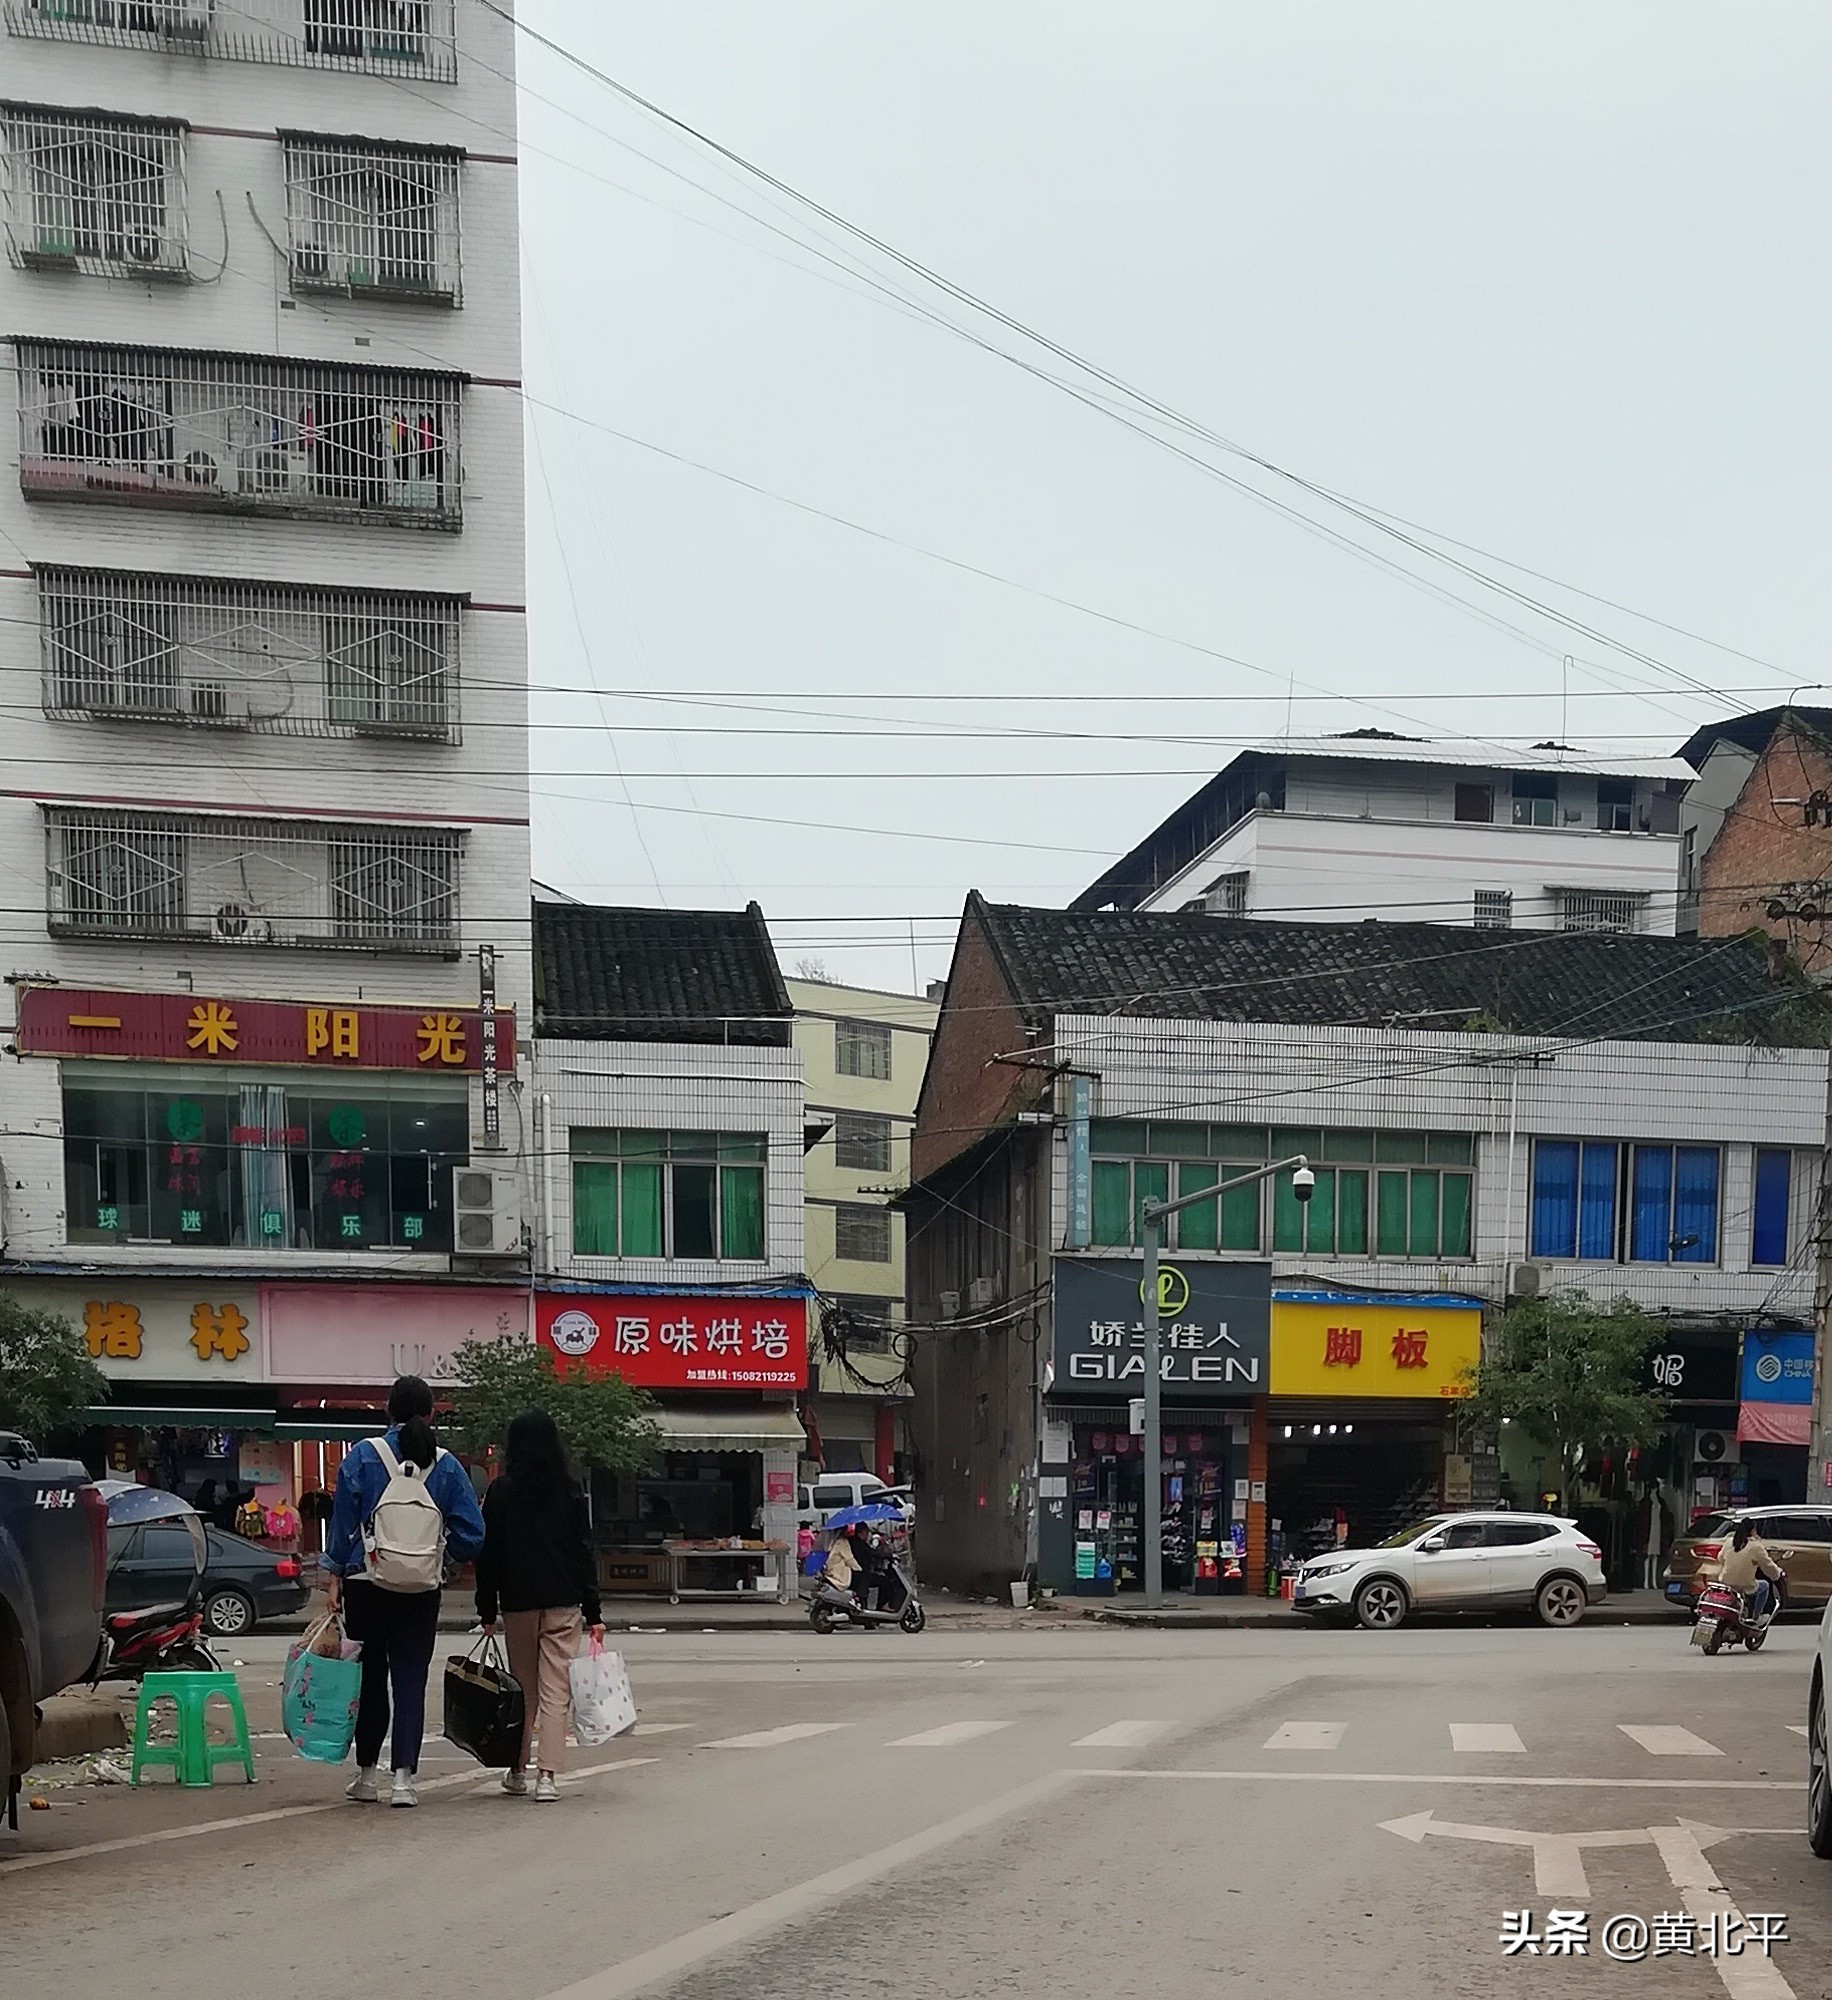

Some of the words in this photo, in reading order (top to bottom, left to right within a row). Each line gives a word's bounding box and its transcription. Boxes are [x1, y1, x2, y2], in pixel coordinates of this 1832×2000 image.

[69, 1002, 466, 1063] 一米阳光
[98, 1207, 424, 1238] 球迷俱乐部
[83, 1301, 250, 1361] 格林
[615, 1316, 790, 1359] 原味烘培
[1089, 1320, 1241, 1350] 娇兰佳人
[1323, 1327, 1429, 1369] 脚板
[1070, 1353, 1259, 1383] GIALEN
